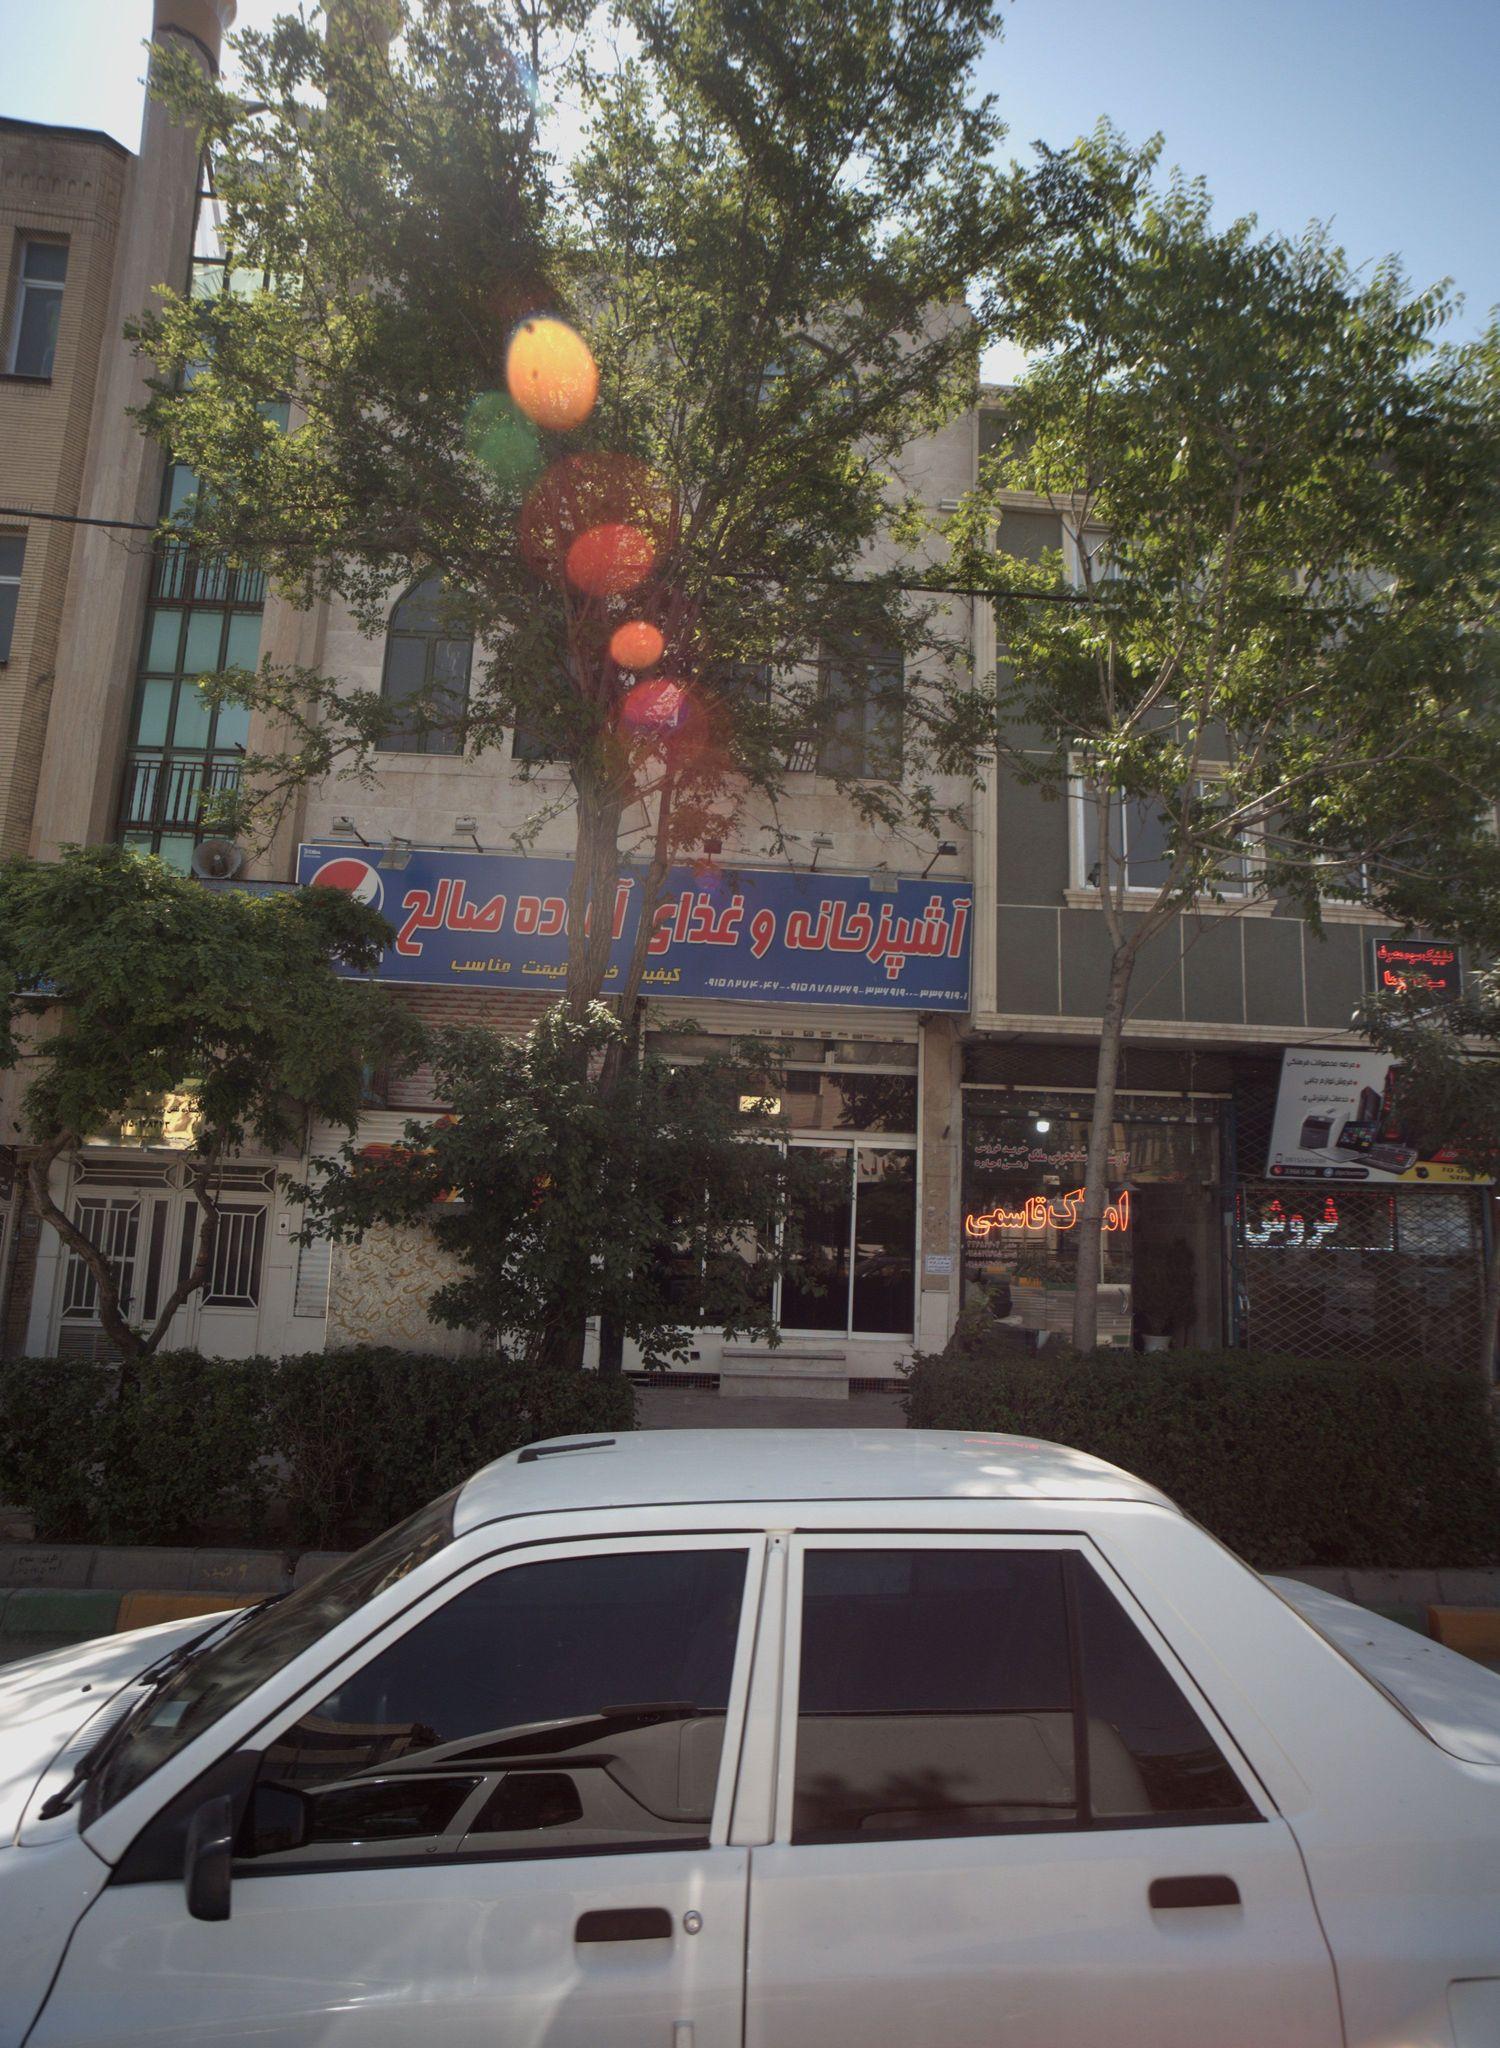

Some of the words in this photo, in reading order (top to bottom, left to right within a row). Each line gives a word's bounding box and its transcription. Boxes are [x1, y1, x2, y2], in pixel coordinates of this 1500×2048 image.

[395, 878, 506, 956] صالح
[513, 878, 635, 940] آده
[649, 892, 744, 955] غذای
[750, 908, 776, 959] و
[785, 895, 971, 979] آشپزخانه
[450, 958, 512, 973] مناسب
[521, 960, 569, 979] قیمت
[965, 1196, 1048, 1236] قاسمی
